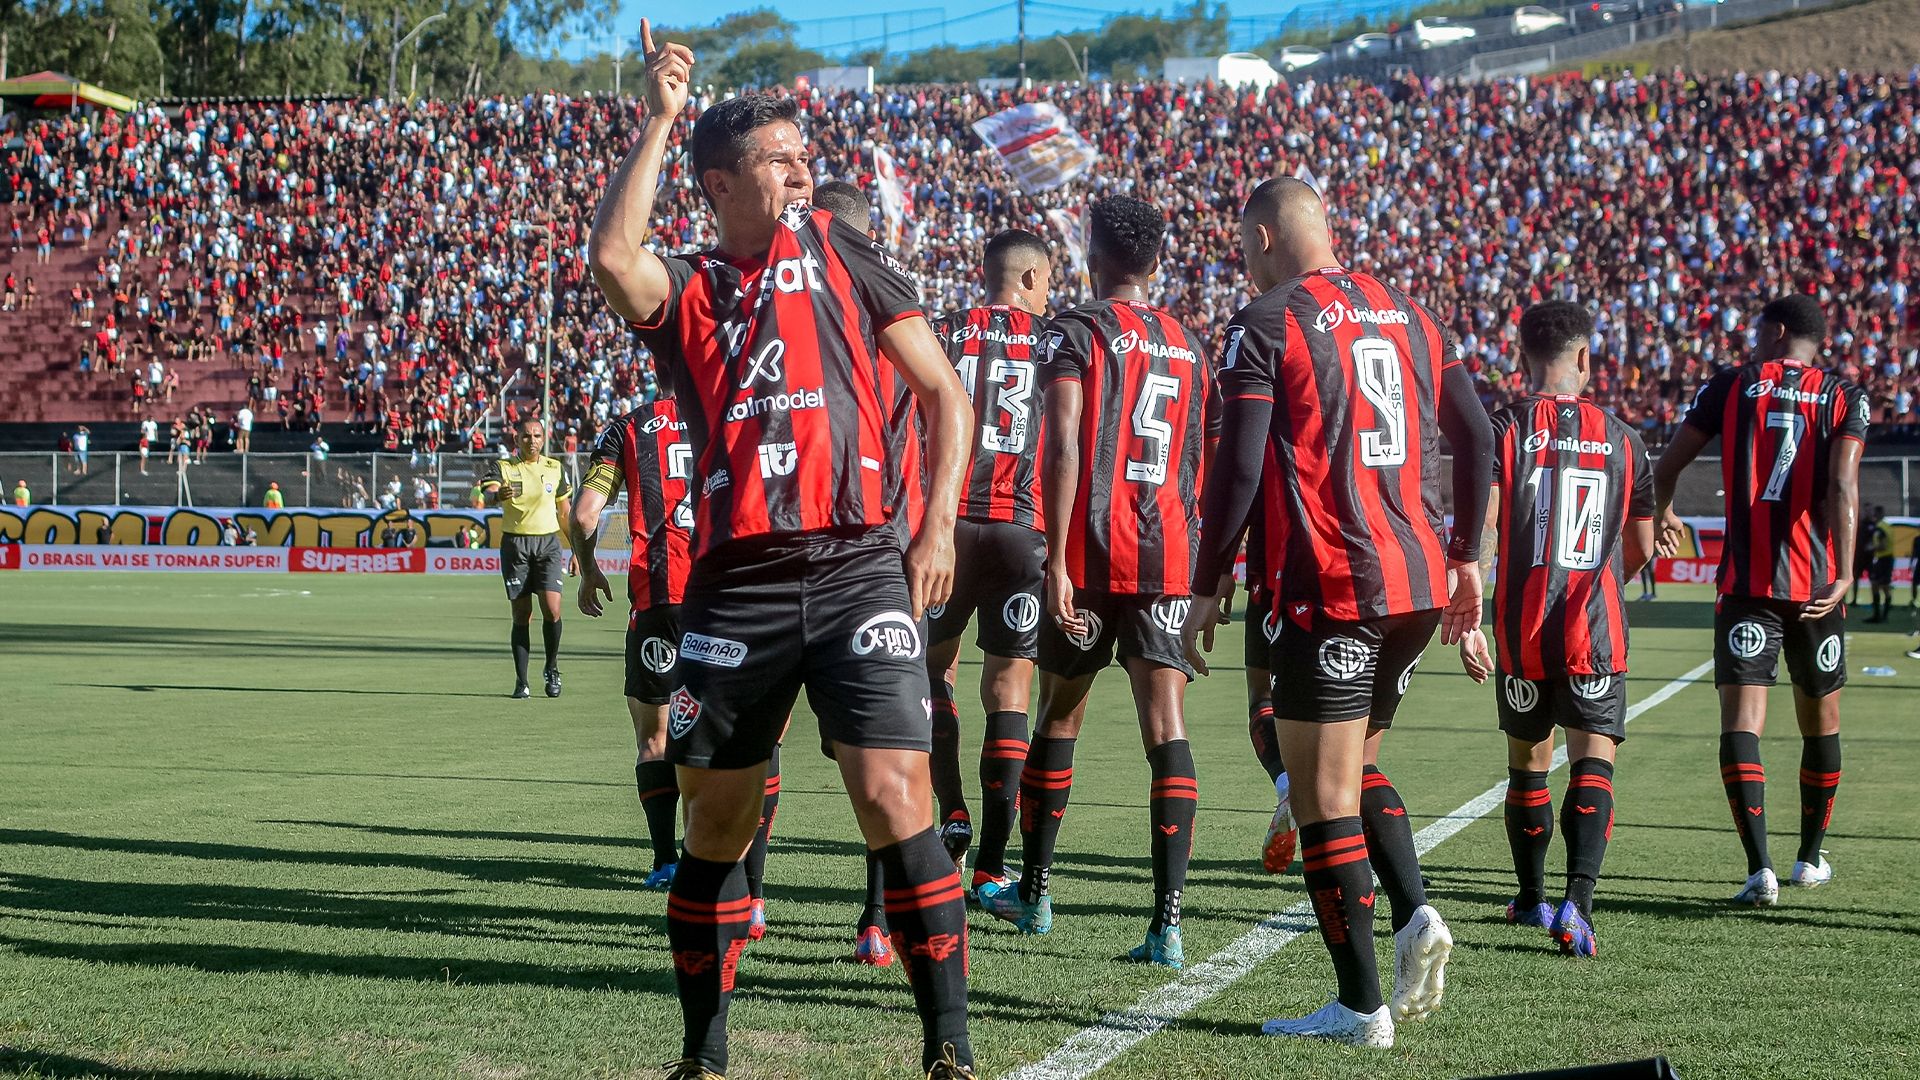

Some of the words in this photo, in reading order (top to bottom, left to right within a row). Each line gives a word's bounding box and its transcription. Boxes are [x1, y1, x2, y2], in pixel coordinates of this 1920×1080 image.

[954, 354, 1035, 454] 13
[1352, 337, 1408, 468] 9
[1394, 382, 1402, 411] SBS
[1015, 416, 1026, 437] SBS
[1126, 373, 1181, 486] 5
[1761, 411, 1807, 501] 7
[1527, 467, 1609, 571] 10
[1539, 508, 1549, 530] SBS
[1592, 513, 1602, 535] SBS
[28, 552, 39, 566] O
[43, 553, 97, 567] BRASIL
[102, 553, 128, 567] VAI
[132, 554, 149, 567] SE
[155, 553, 220, 568] TORNAR
[224, 554, 281, 569] SUPER!
[301, 550, 414, 573] SUPERBET
[434, 556, 447, 570] O
[450, 556, 500, 571] BRASI
[683, 634, 741, 659] BAIANÃO
